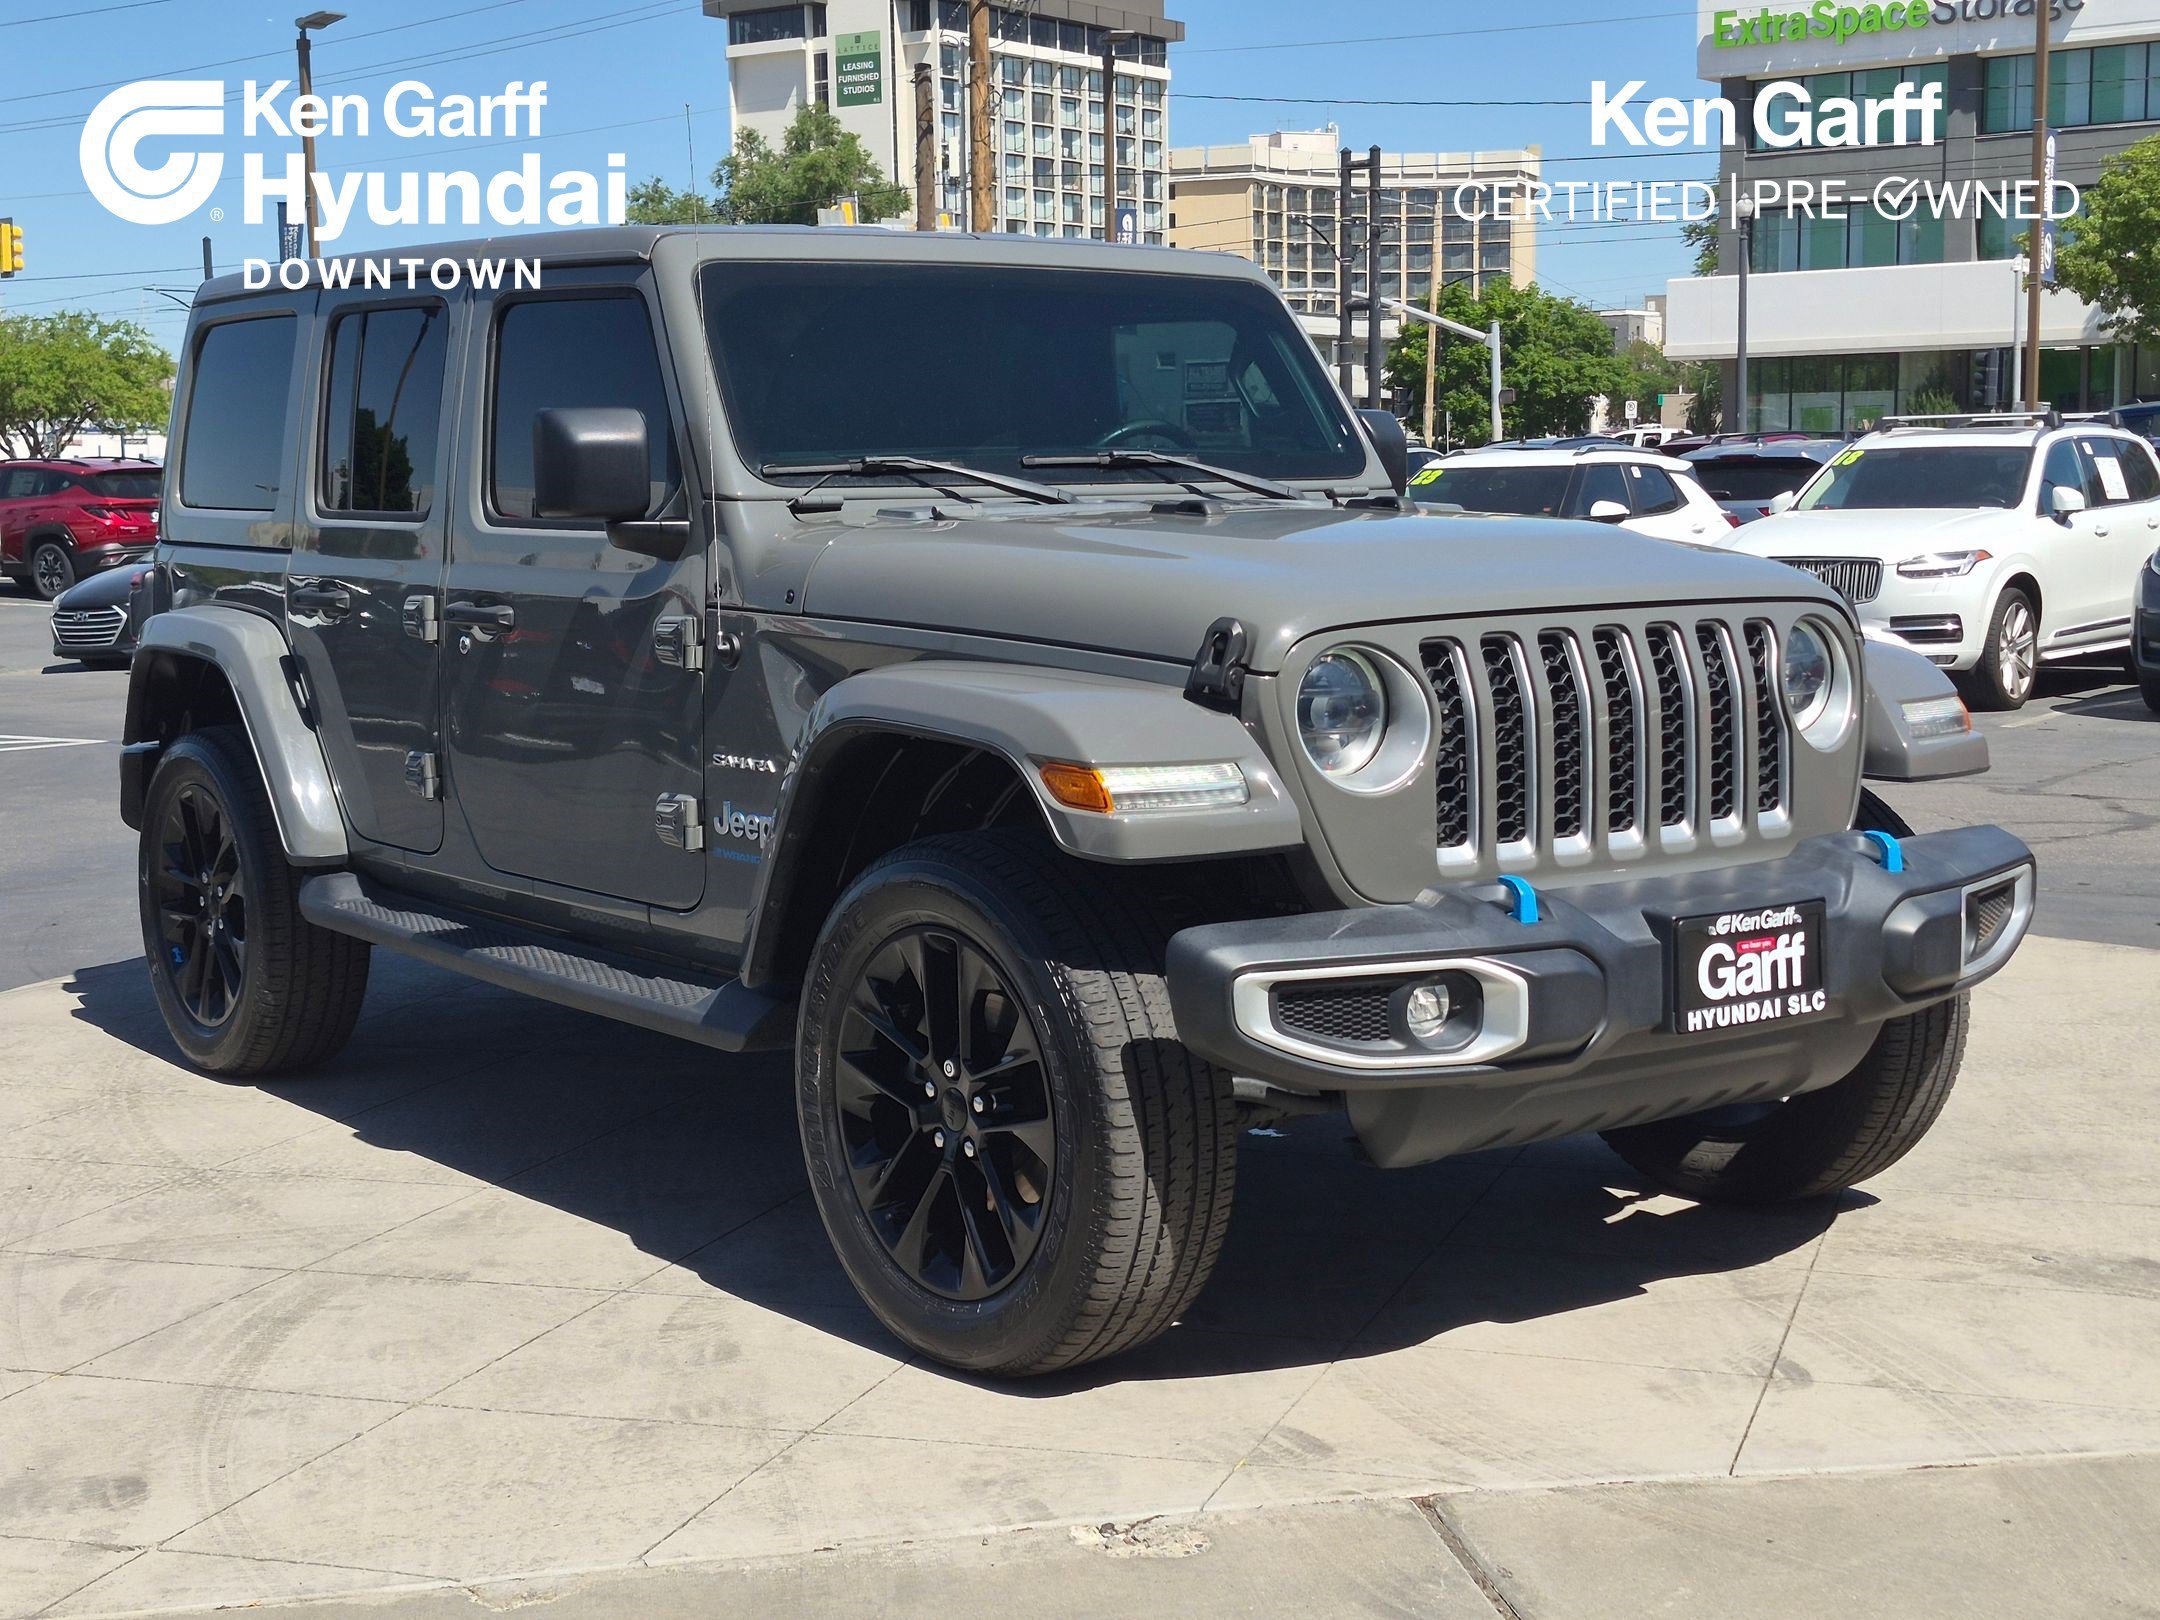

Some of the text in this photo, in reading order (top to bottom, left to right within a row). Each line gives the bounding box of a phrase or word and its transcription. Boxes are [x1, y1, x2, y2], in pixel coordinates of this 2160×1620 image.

[837, 43, 879, 54] LATTICE
[842, 61, 875, 72] LEASING
[838, 72, 880, 84] FURNISHED
[843, 84, 876, 95] STUDIOS
[1409, 469, 1444, 485] 23
[712, 753, 777, 773] SAHARA
[713, 800, 777, 849] Jeep
[1730, 906, 1796, 934] Ken Garff
[1698, 931, 1806, 1001] Garff
[1687, 990, 1826, 1032] HYUNDAI SLC
